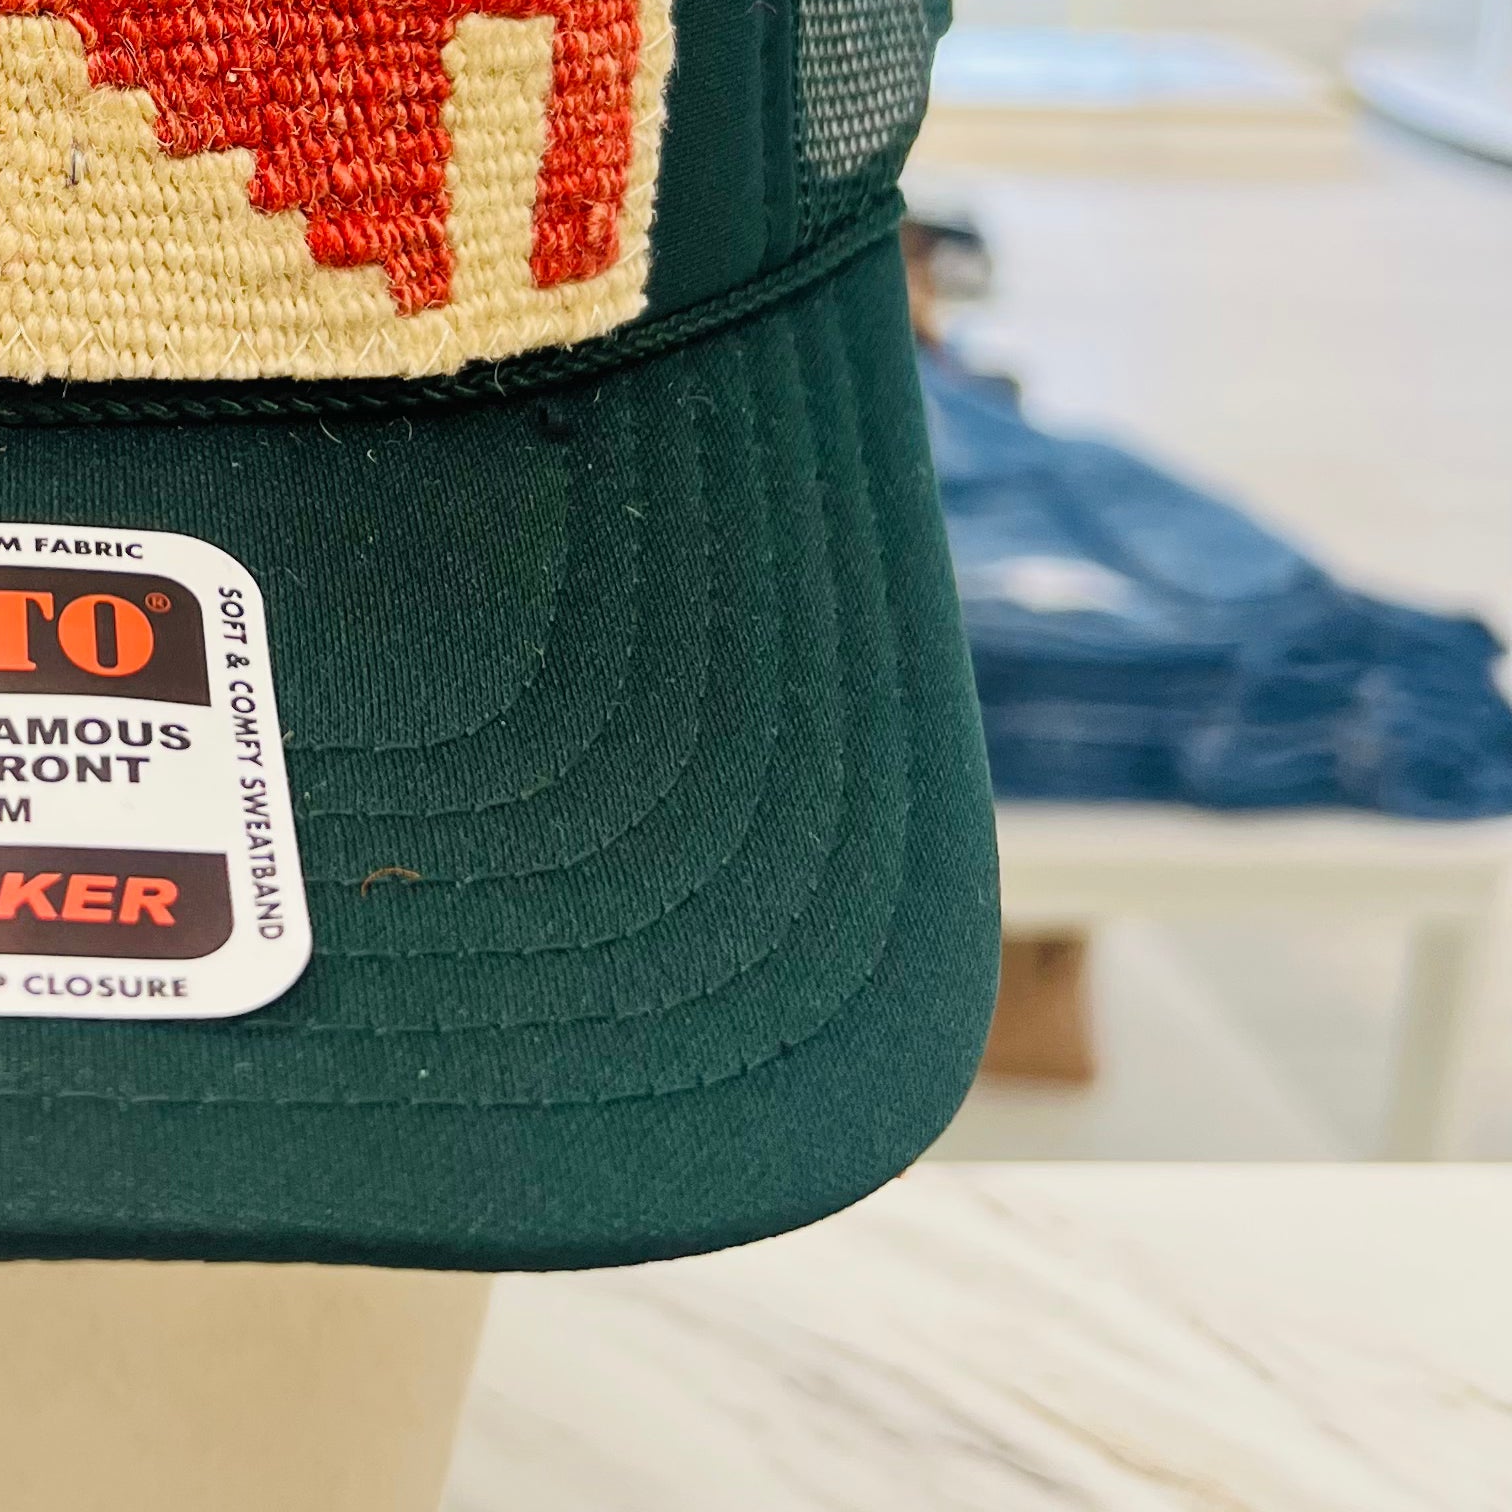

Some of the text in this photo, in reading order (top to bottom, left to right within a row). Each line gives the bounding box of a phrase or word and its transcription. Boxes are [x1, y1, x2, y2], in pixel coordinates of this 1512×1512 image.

[35, 536, 144, 560] FABRIC
[218, 586, 284, 940] SOFT & COMFY SWEATBAND
[23, 974, 190, 998] CLOSURE
